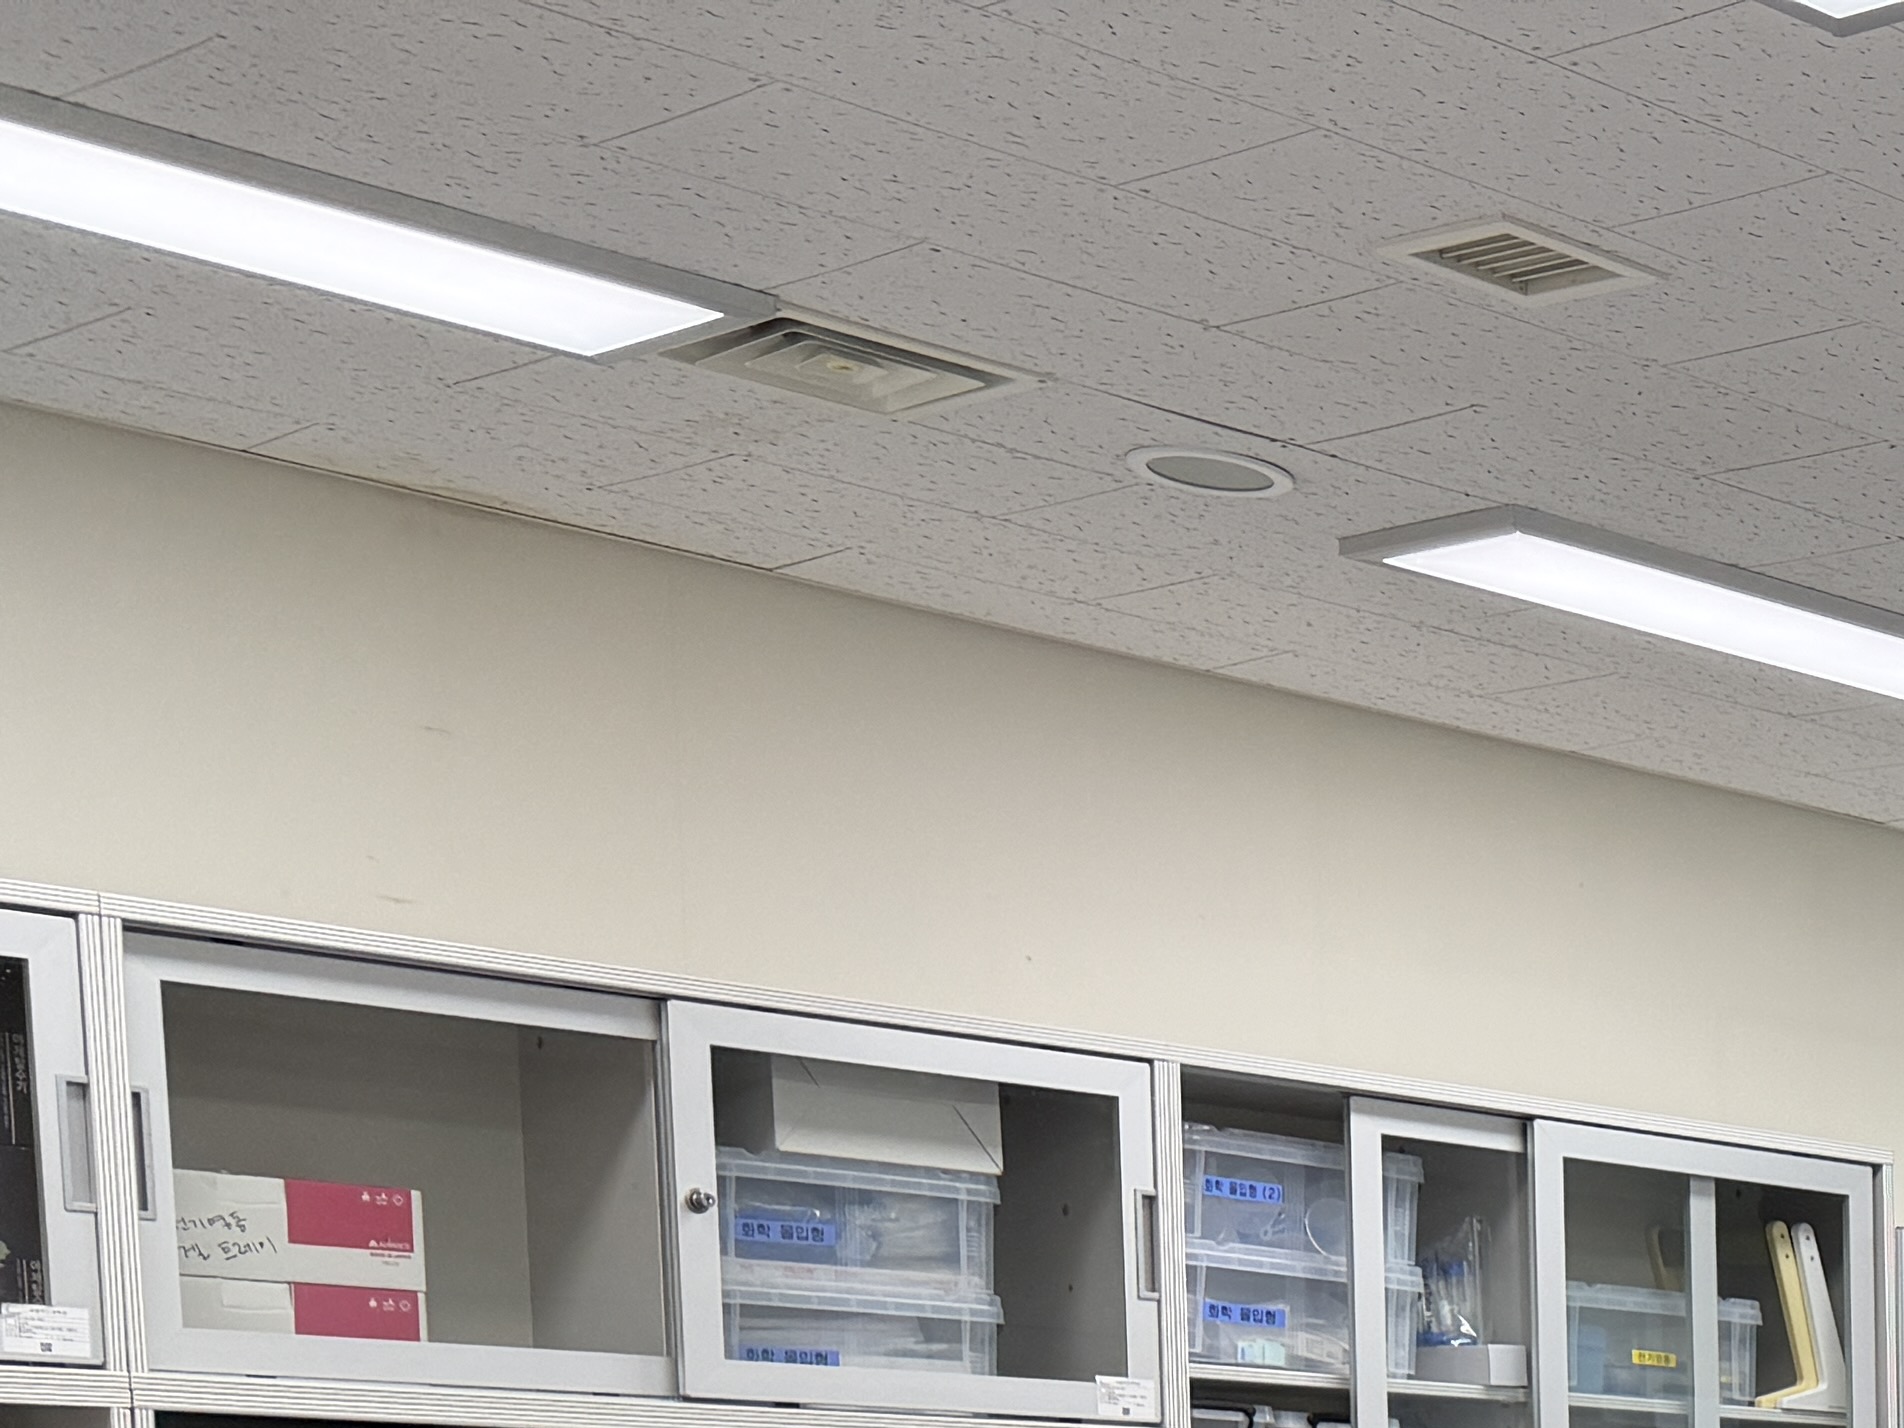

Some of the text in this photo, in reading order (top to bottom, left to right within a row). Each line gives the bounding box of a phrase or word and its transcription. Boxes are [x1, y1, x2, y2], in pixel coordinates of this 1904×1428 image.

[1262, 1186, 1281, 1201] (2)
[741, 1221, 771, 1239] 화학
[1208, 1303, 1233, 1320] 화학
